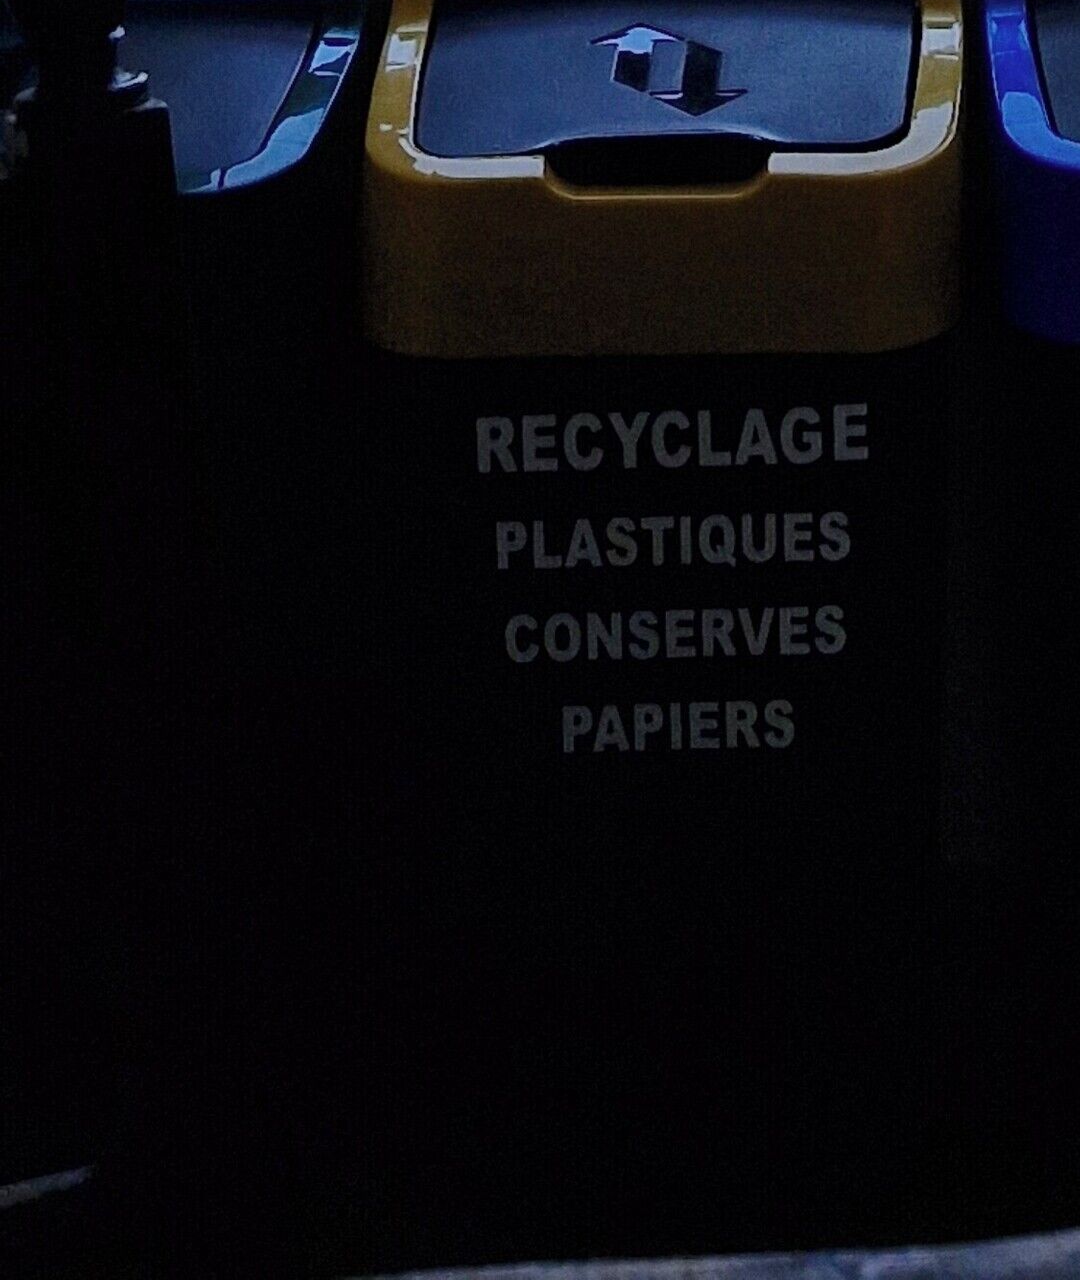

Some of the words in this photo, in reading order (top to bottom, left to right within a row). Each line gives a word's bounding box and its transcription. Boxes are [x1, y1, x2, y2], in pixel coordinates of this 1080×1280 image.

[476, 403, 869, 473] RECYCLAGE
[496, 511, 851, 569] PLASTIQUES
[505, 605, 847, 663] CONSERVES
[562, 699, 795, 753] PAPIERS
